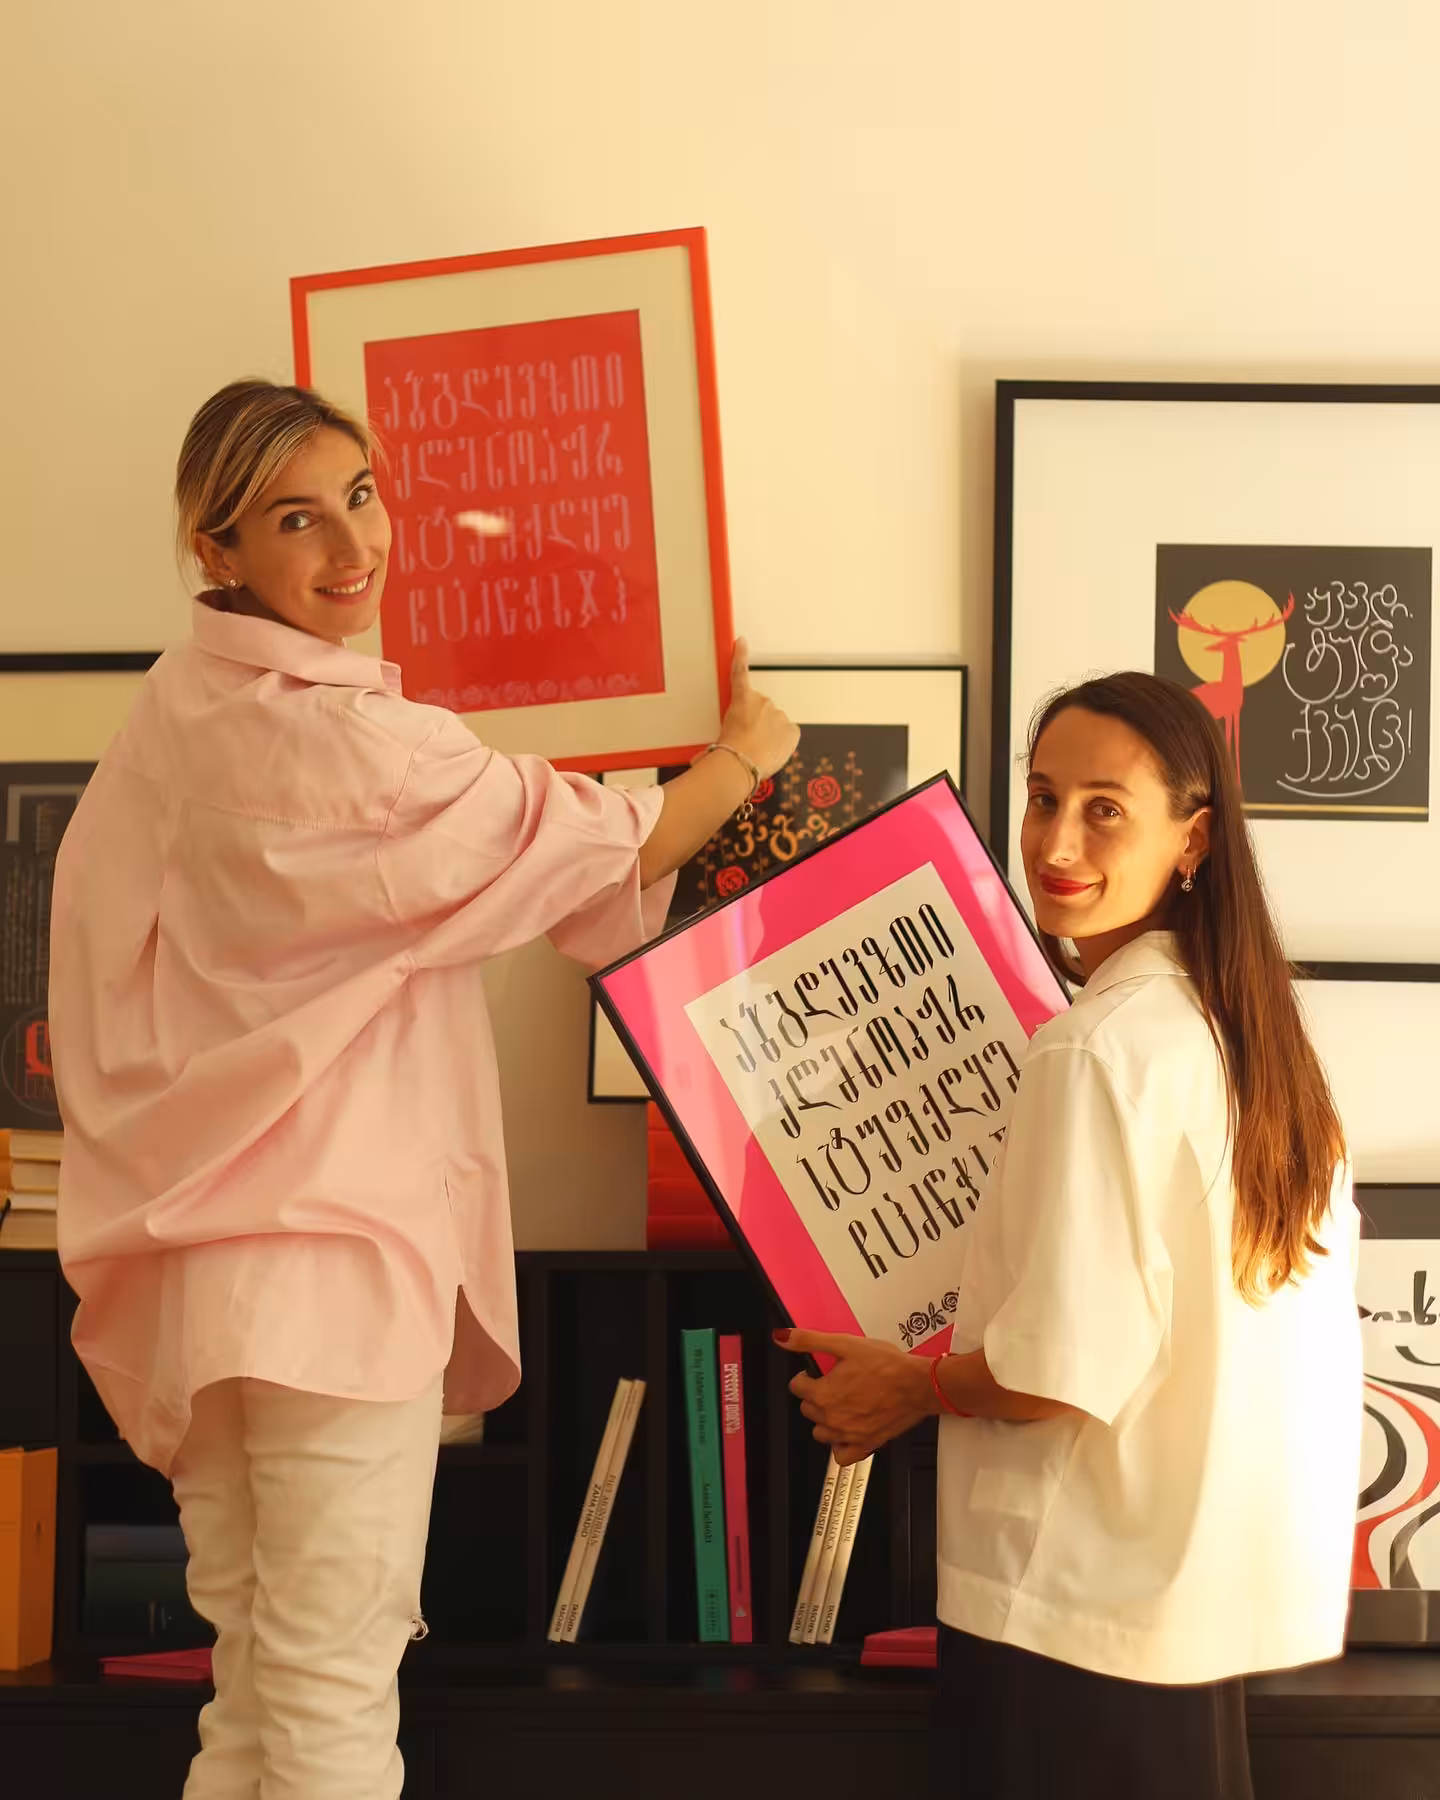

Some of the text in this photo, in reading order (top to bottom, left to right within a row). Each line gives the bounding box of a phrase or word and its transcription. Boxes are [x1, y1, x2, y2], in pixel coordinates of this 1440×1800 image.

[816, 1489, 833, 1537] CORBUSIER
[807, 1604, 820, 1634] TASCHEN
[823, 1604, 835, 1634] TASCHEN
